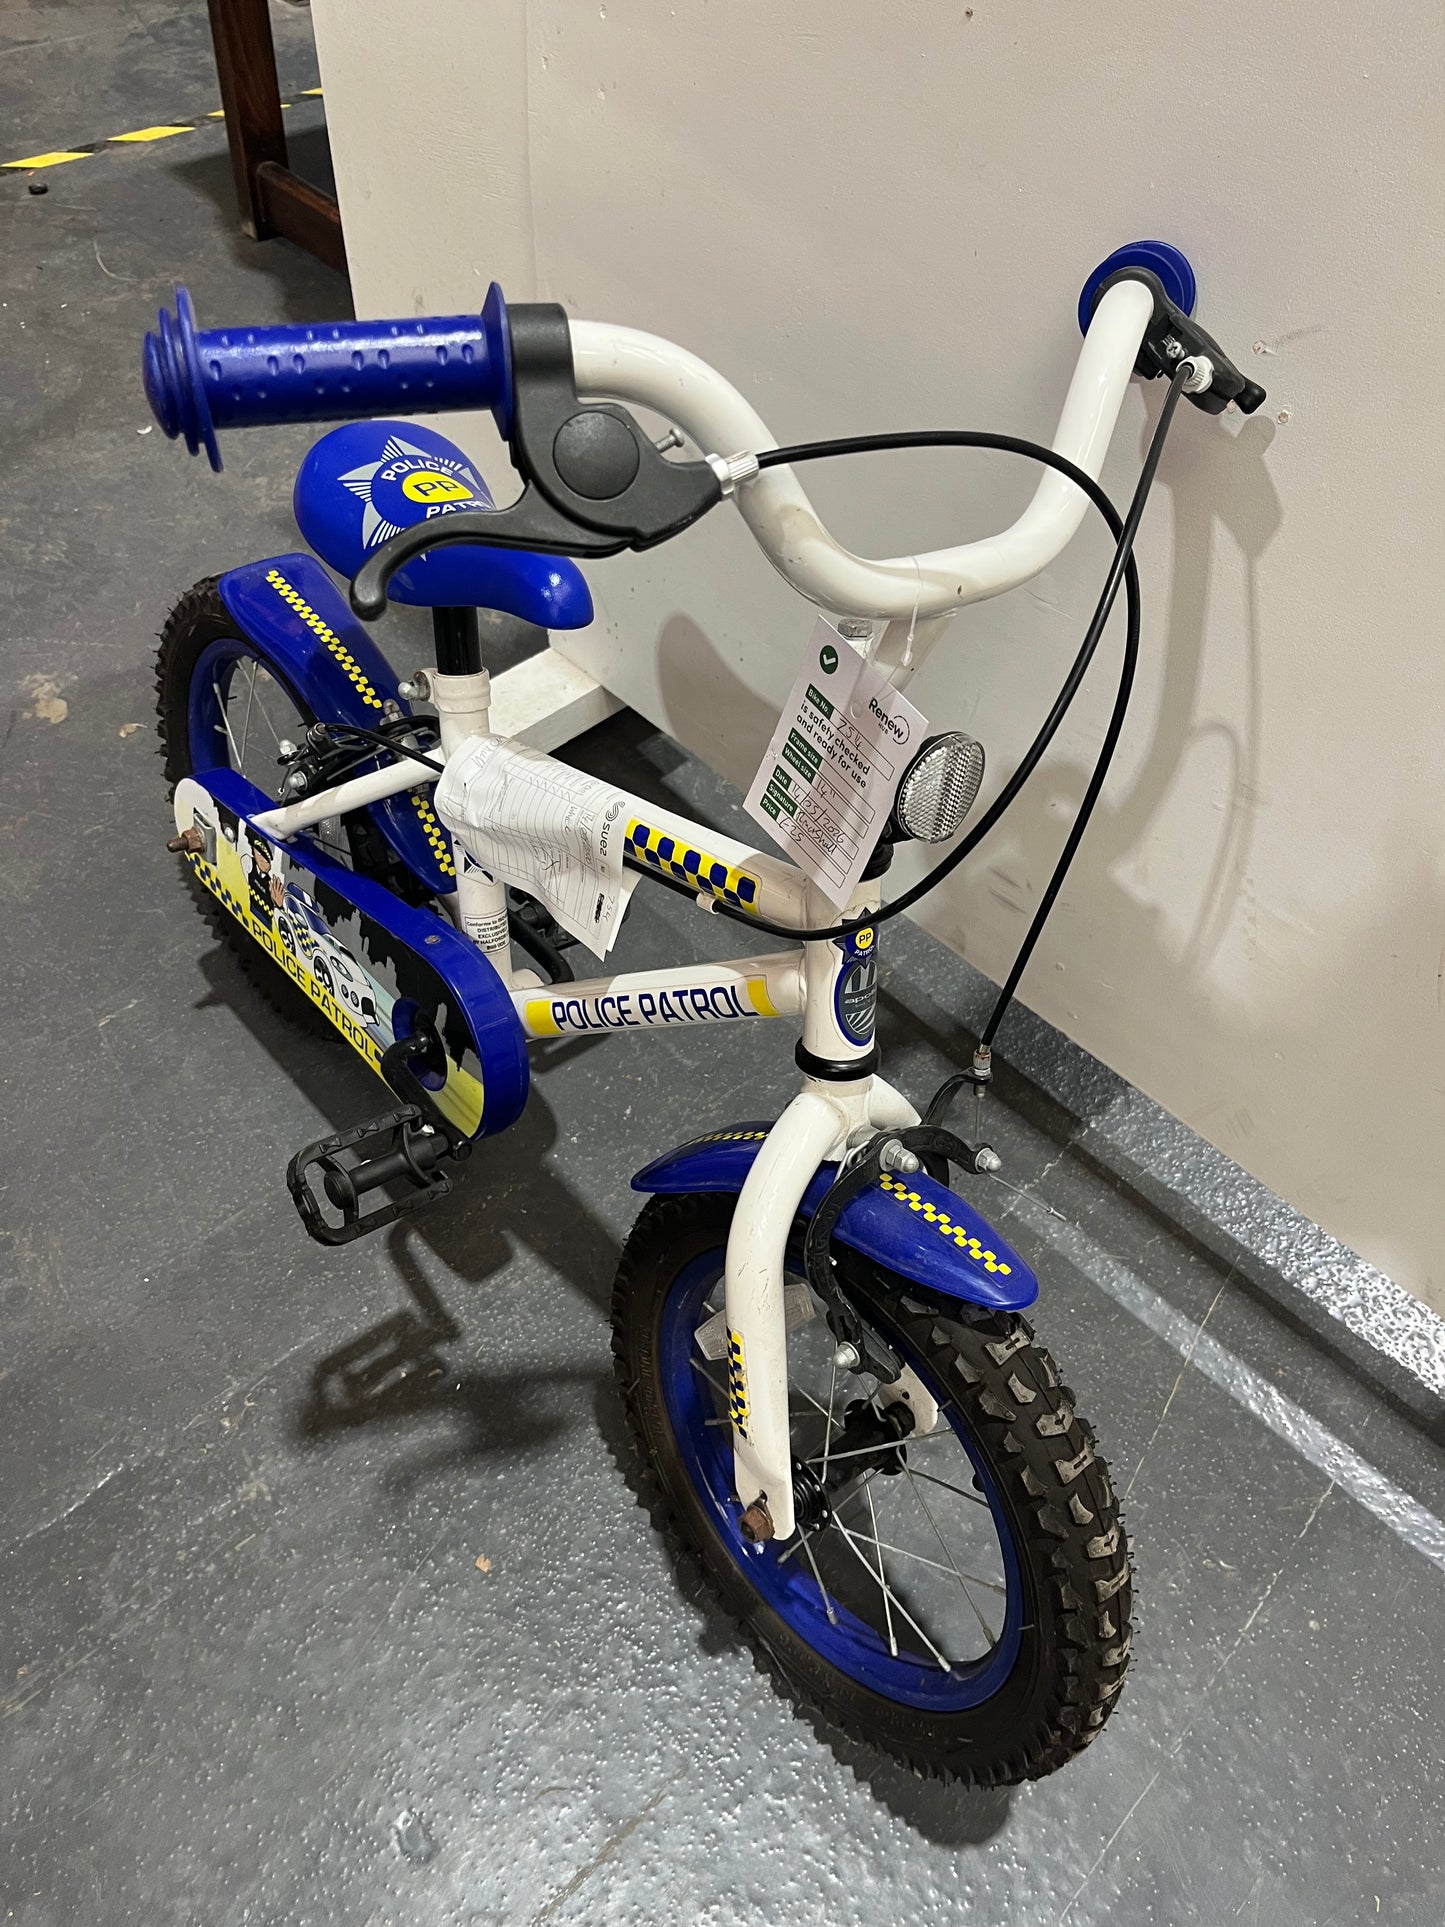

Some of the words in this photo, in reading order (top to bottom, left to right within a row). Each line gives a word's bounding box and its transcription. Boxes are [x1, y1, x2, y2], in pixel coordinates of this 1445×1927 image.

[381, 459, 454, 481] POLICE
[413, 480, 459, 496] PP
[807, 688, 820, 704] Bike
[819, 700, 829, 714] No.
[868, 697, 905, 740] Renew
[878, 722, 888, 735] HUB
[790, 732, 808, 754] Frame
[807, 749, 818, 764] size
[795, 711, 813, 734] and
[811, 729, 838, 761] ready
[837, 753, 851, 772] for
[850, 768, 867, 789] use
[800, 700, 809, 713] is
[807, 708, 835, 742] safety
[834, 734, 870, 776] checked
[774, 768, 788, 785] Date
[784, 747, 801, 768] Wheel
[800, 763, 812, 779] size
[762, 797, 776, 816] Price
[768, 782, 793, 812] Signature
[860, 932, 871, 944] PP
[253, 924, 307, 986] POLICE
[310, 982, 375, 1062] PATROL
[552, 995, 641, 1032] POLICE
[638, 985, 761, 1024] PATROL
